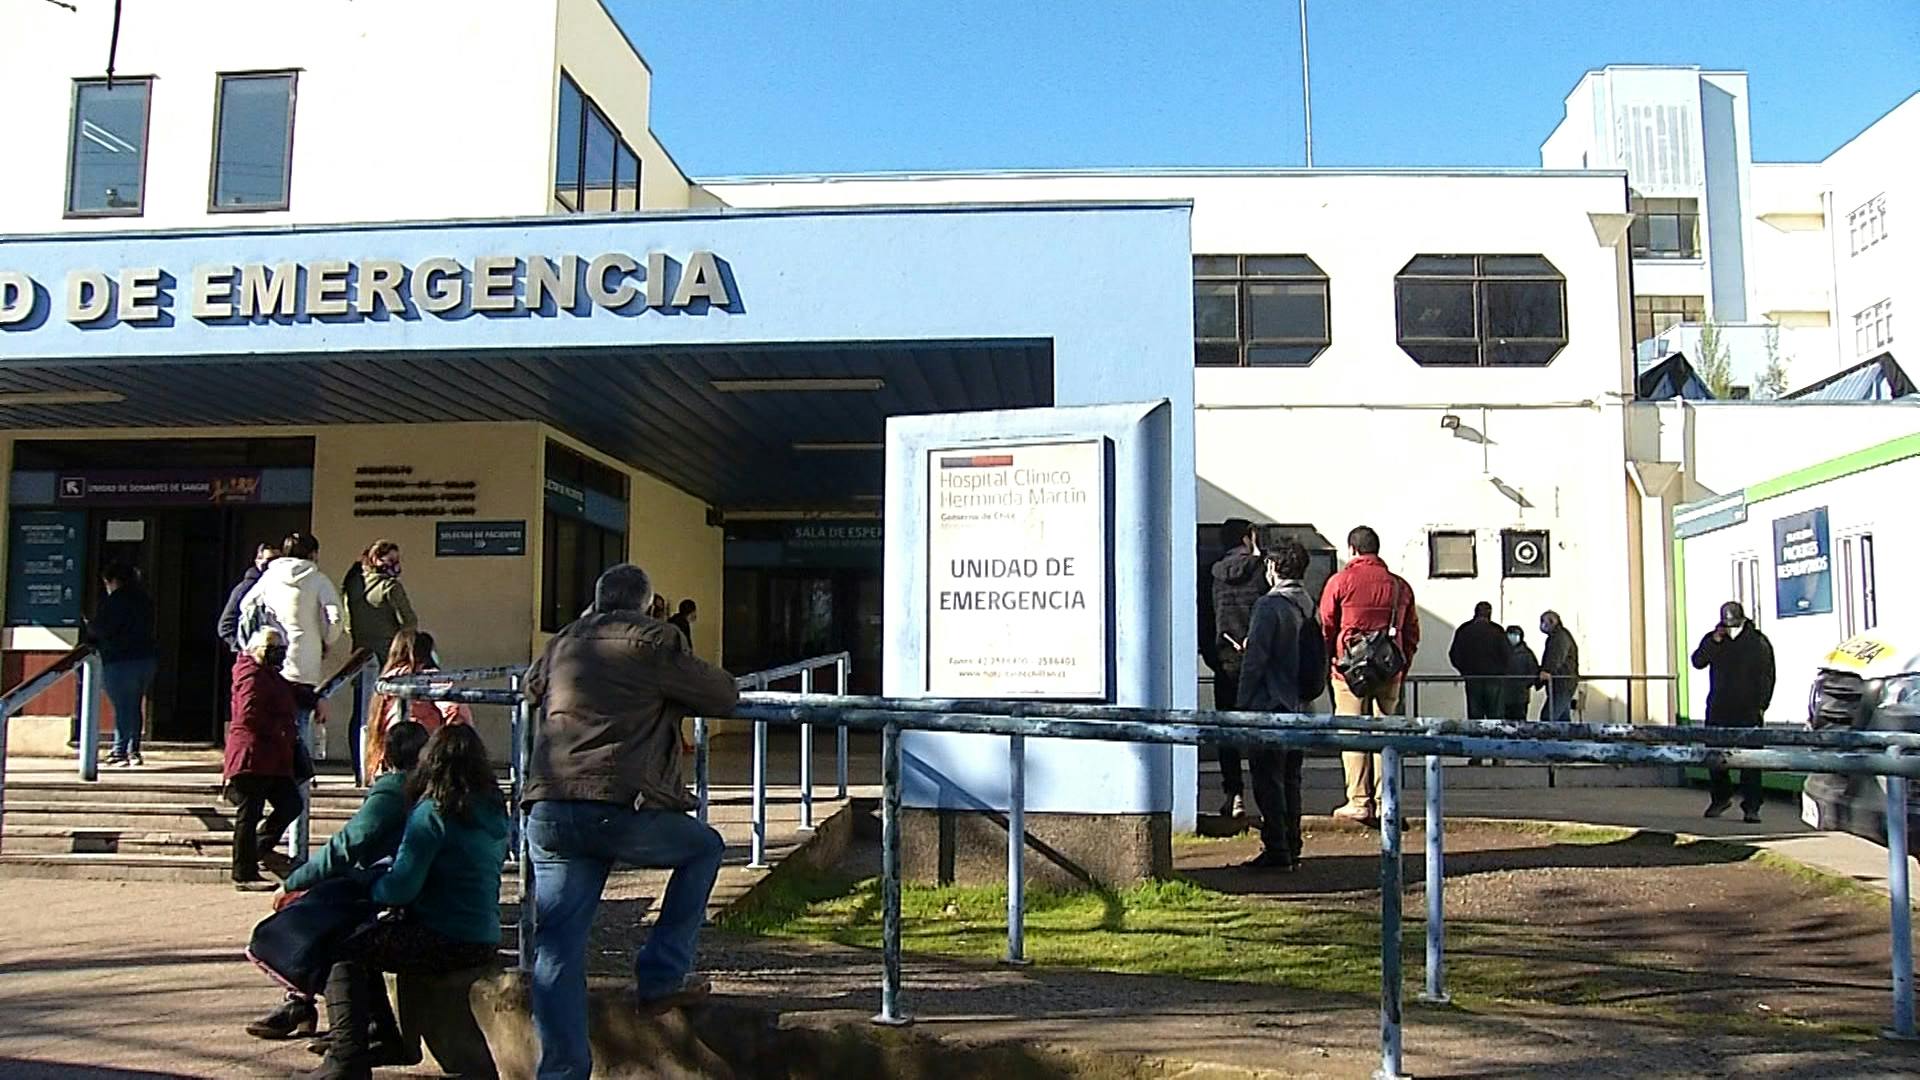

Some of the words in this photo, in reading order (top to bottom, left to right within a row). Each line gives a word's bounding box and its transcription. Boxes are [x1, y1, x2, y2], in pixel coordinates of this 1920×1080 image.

[67, 267, 174, 329] DE
[192, 250, 744, 326] EMERGENCIA
[940, 469, 1008, 491] Hospital
[795, 527, 825, 538] SALA
[828, 527, 845, 538] DE
[951, 558, 1038, 578] UNIDAD
[1046, 557, 1075, 576] DE
[939, 590, 1086, 610] EMERGENCIA
